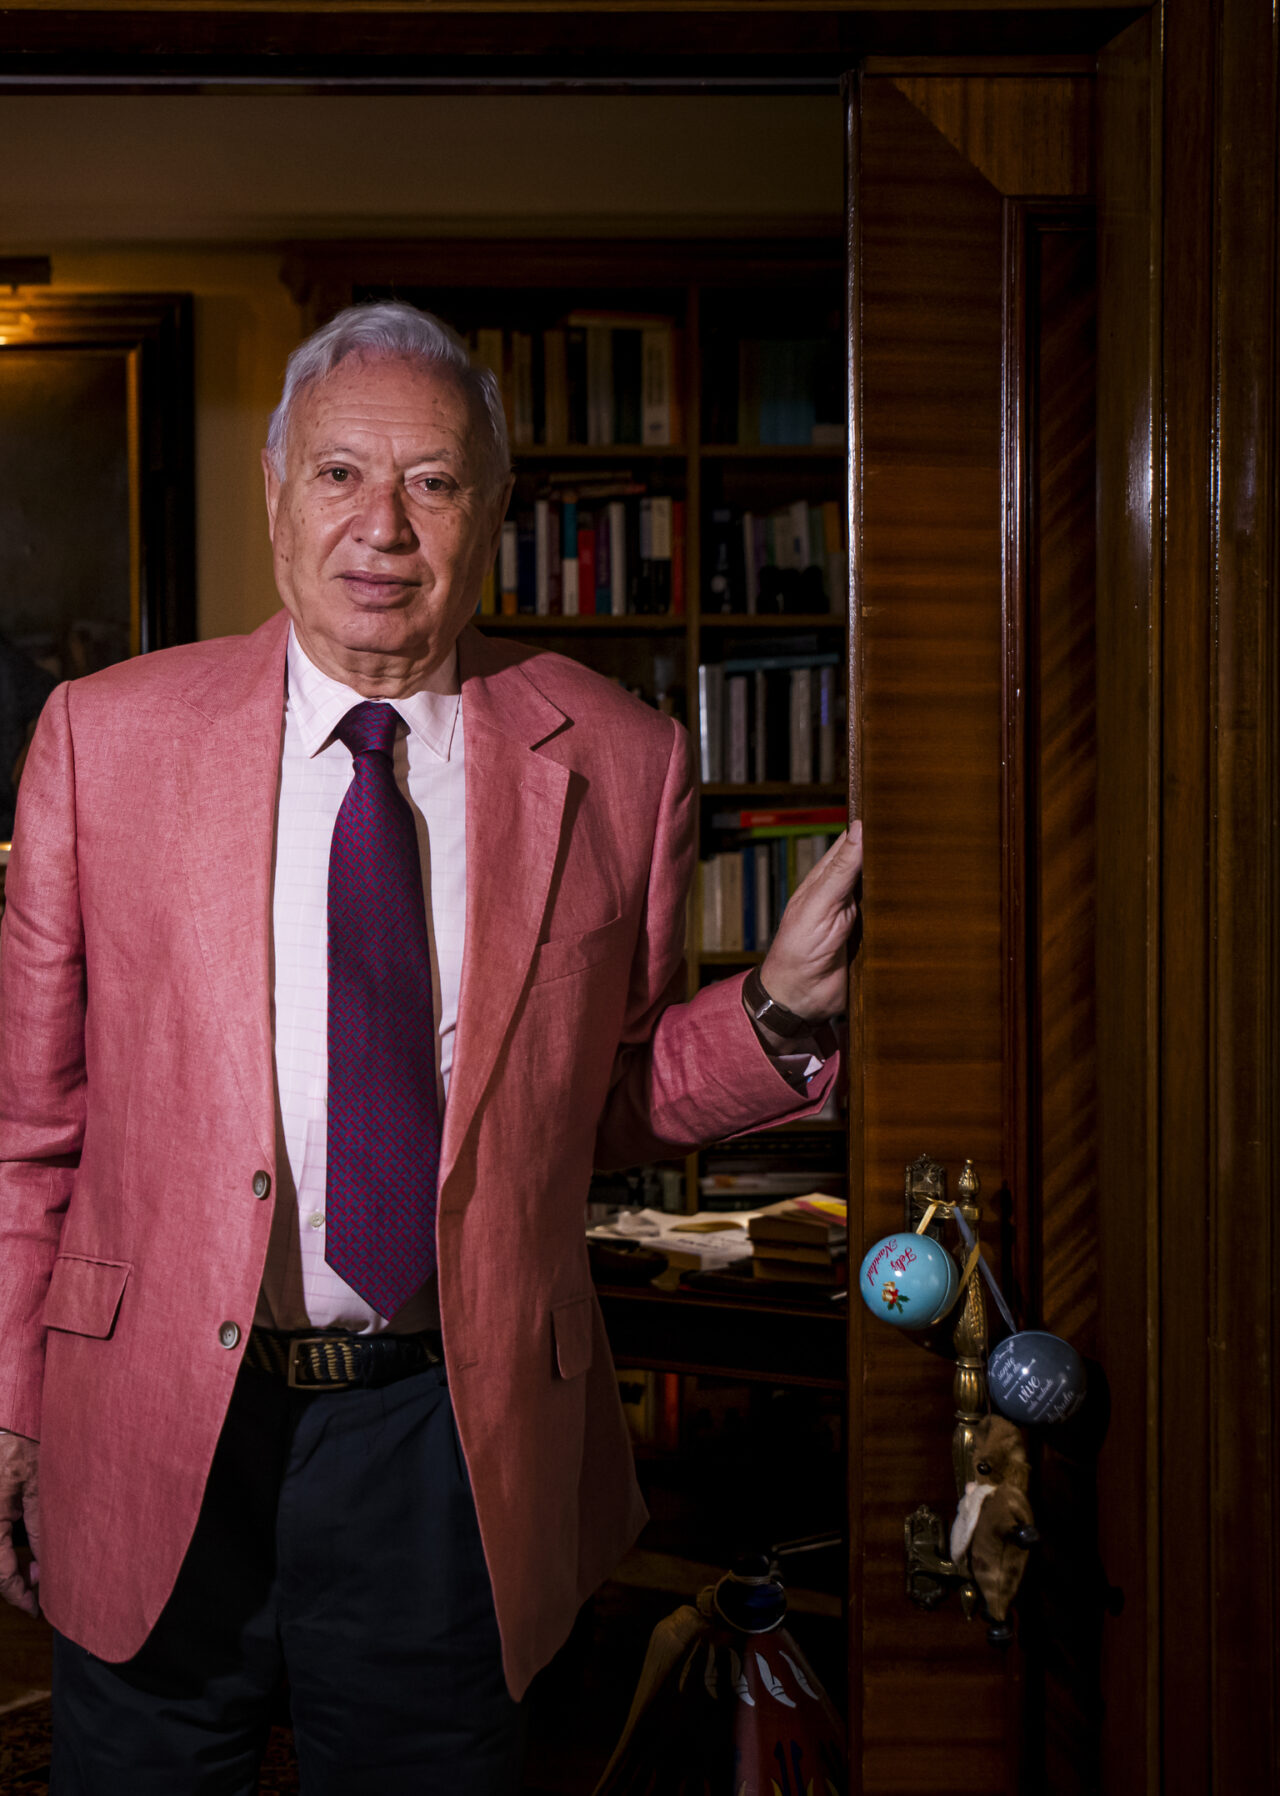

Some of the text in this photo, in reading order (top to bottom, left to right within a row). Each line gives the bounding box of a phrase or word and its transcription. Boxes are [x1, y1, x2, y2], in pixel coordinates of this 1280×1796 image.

[867, 1239, 898, 1286] Navidad
[890, 1246, 917, 1272] Feliz
[1018, 1375, 1040, 1404] vive
